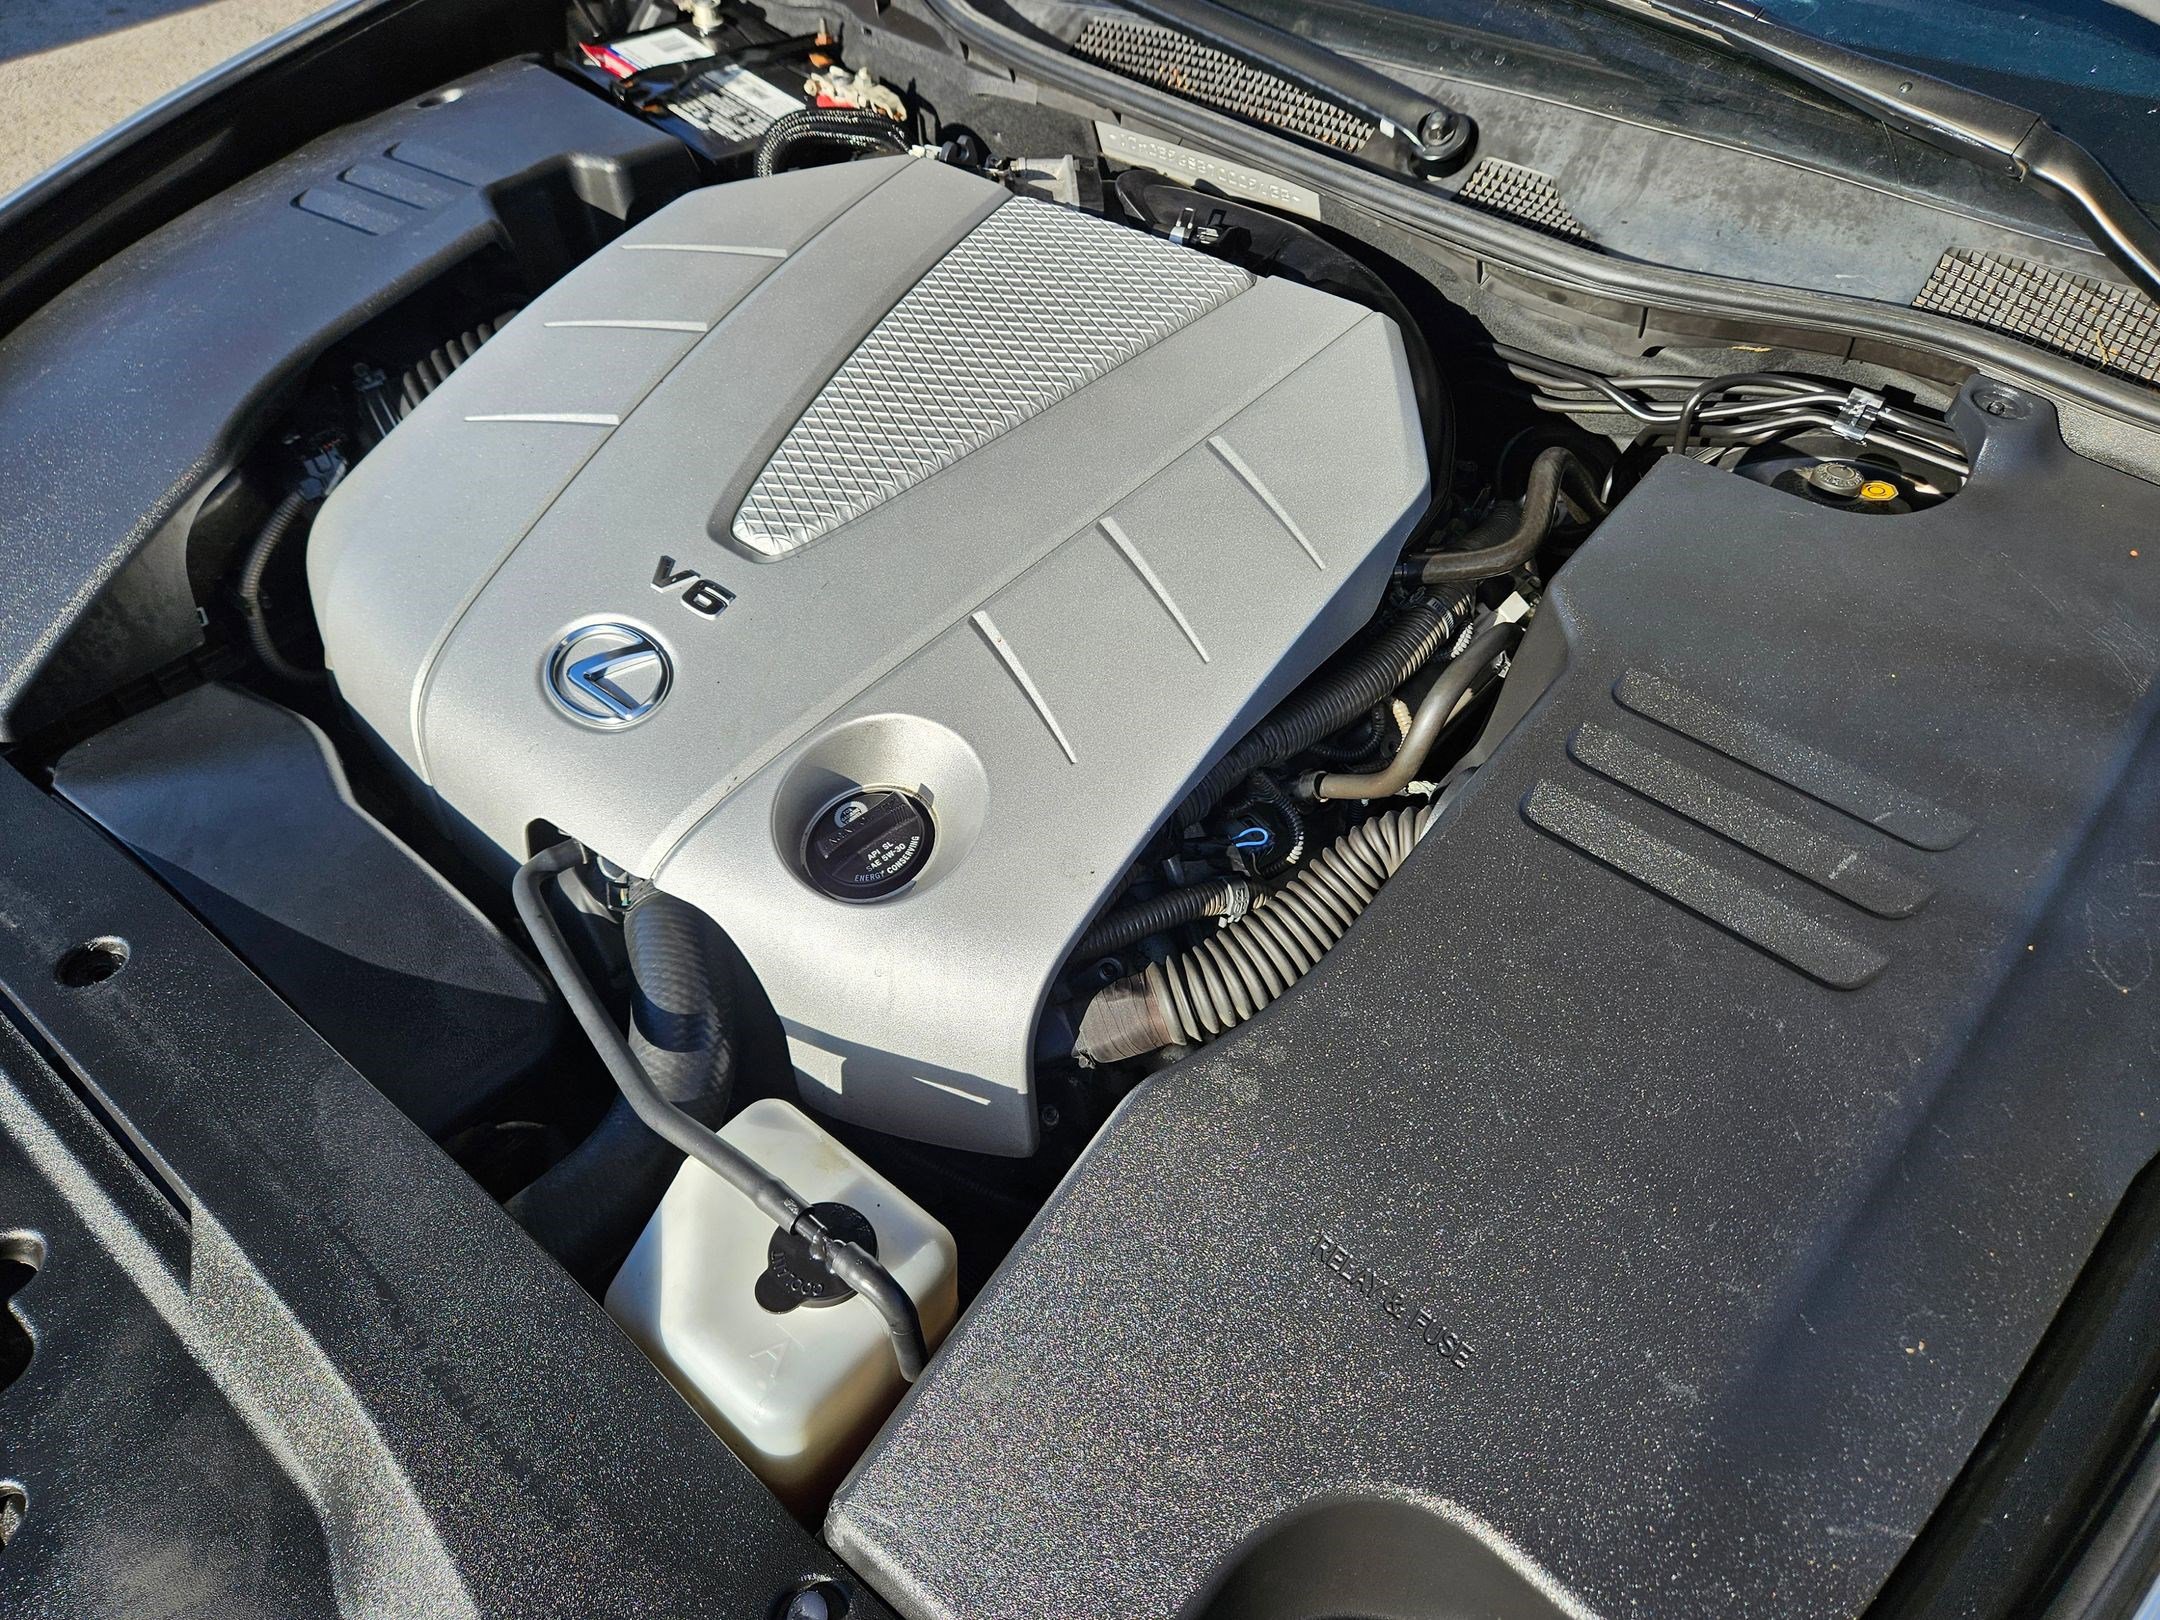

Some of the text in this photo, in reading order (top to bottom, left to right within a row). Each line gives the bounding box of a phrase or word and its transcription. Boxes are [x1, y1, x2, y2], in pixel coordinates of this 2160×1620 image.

[650, 555, 737, 621] V6
[854, 835, 920, 882] ENERGY CONSERVING
[866, 843, 907, 873] SAE 5W-30
[867, 841, 894, 861] API SL
[1311, 1233, 1389, 1299] RELAY
[1407, 1308, 1475, 1369] FUSE
